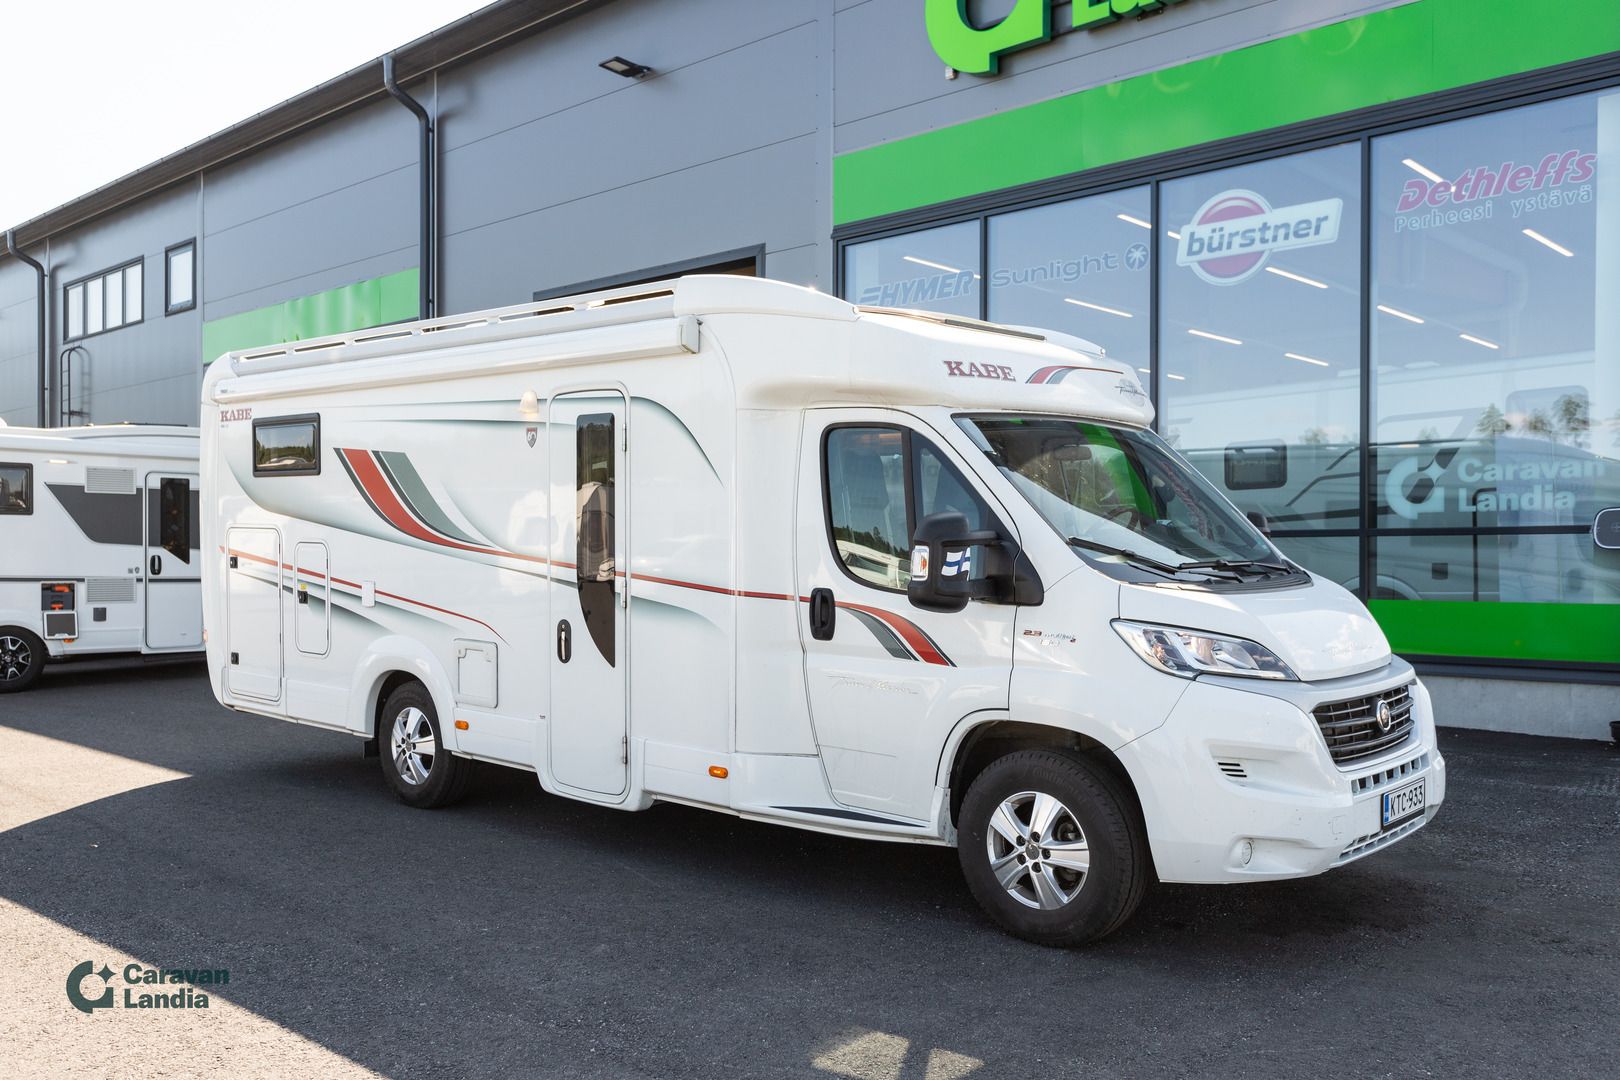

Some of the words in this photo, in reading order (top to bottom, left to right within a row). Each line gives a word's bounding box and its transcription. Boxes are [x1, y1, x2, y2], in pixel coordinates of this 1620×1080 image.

[1395, 150, 1598, 214] Dethleffs
[1394, 202, 1493, 232] Perheesi
[1511, 185, 1593, 218] ystävä
[1186, 215, 1329, 257] bürstner
[991, 253, 1120, 288] Sunlight
[877, 270, 975, 308] HYMER
[943, 360, 1017, 382] KABE
[220, 408, 252, 423] KABE
[1457, 457, 1605, 483] Caravan
[1458, 484, 1577, 513] Landia
[1390, 784, 1423, 817] KTC-933
